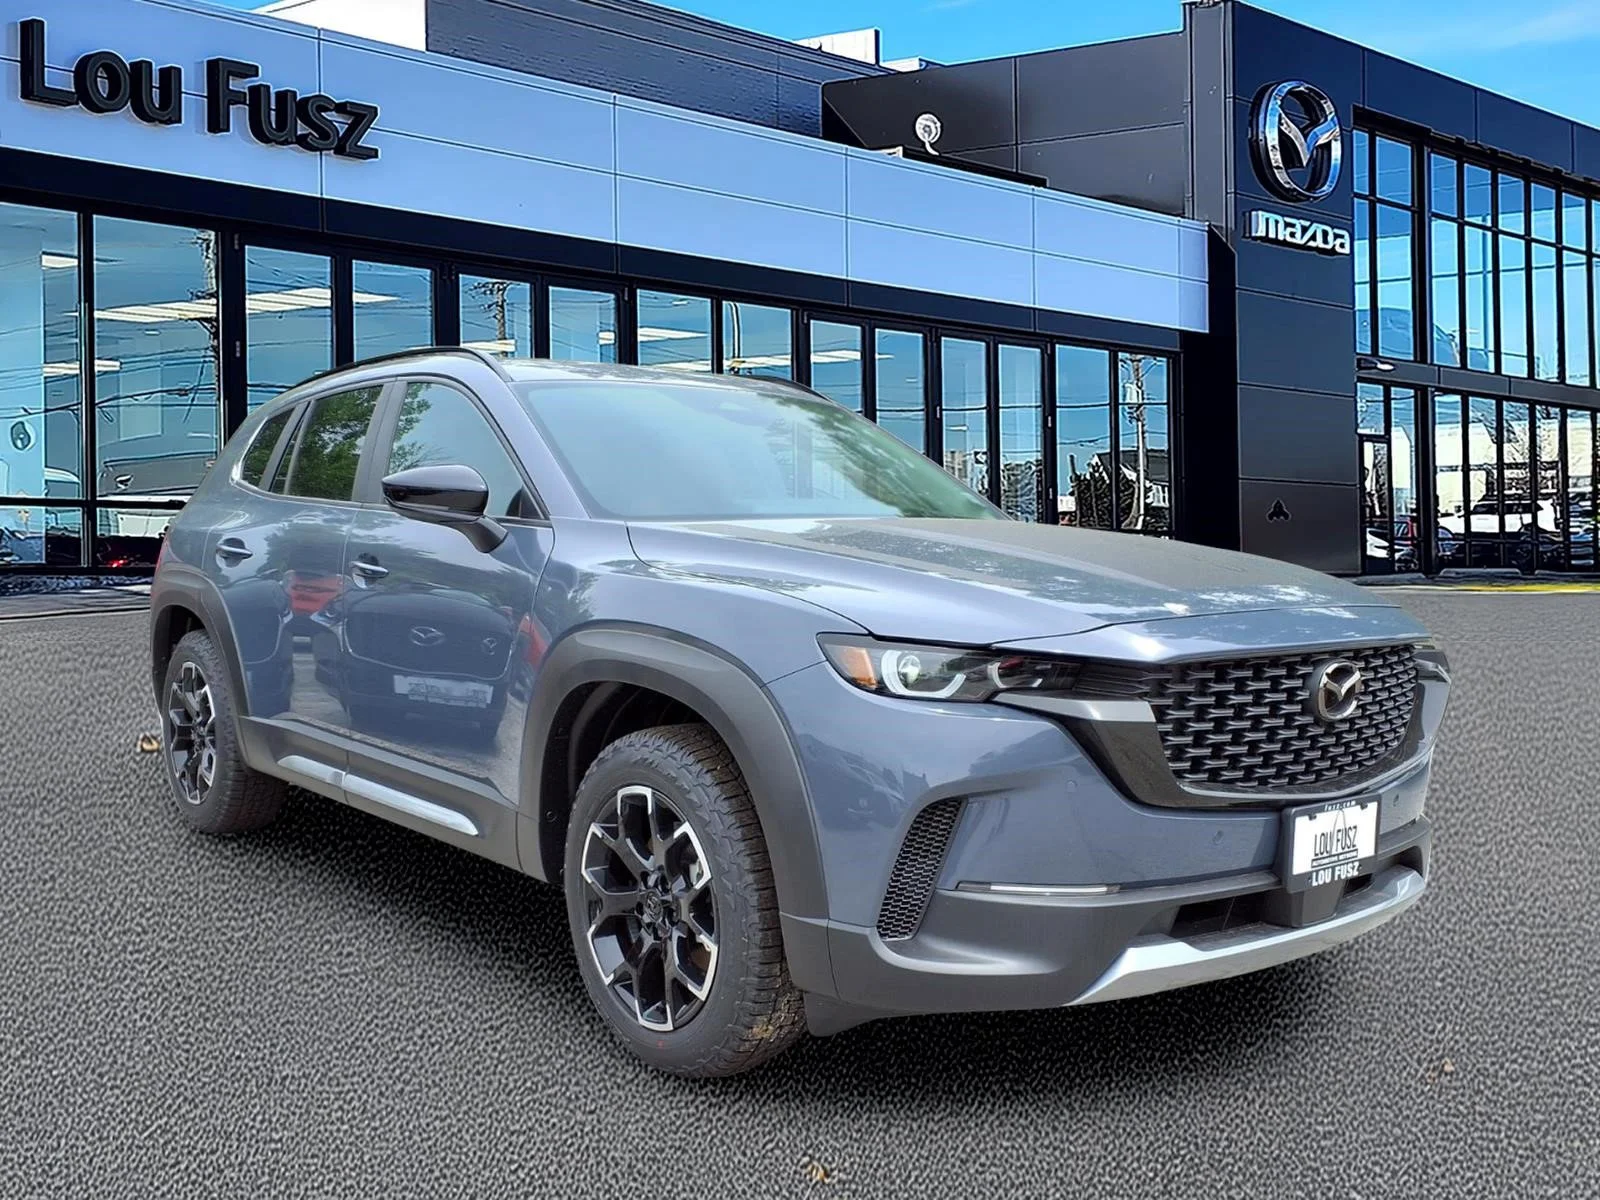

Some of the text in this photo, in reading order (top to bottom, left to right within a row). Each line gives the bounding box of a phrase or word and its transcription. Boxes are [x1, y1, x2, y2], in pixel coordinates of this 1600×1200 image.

[19, 17, 380, 161] Lou Fusz
[1314, 825, 1358, 857] LOU FUSZ
[1312, 861, 1360, 887] LOU FUSZ
